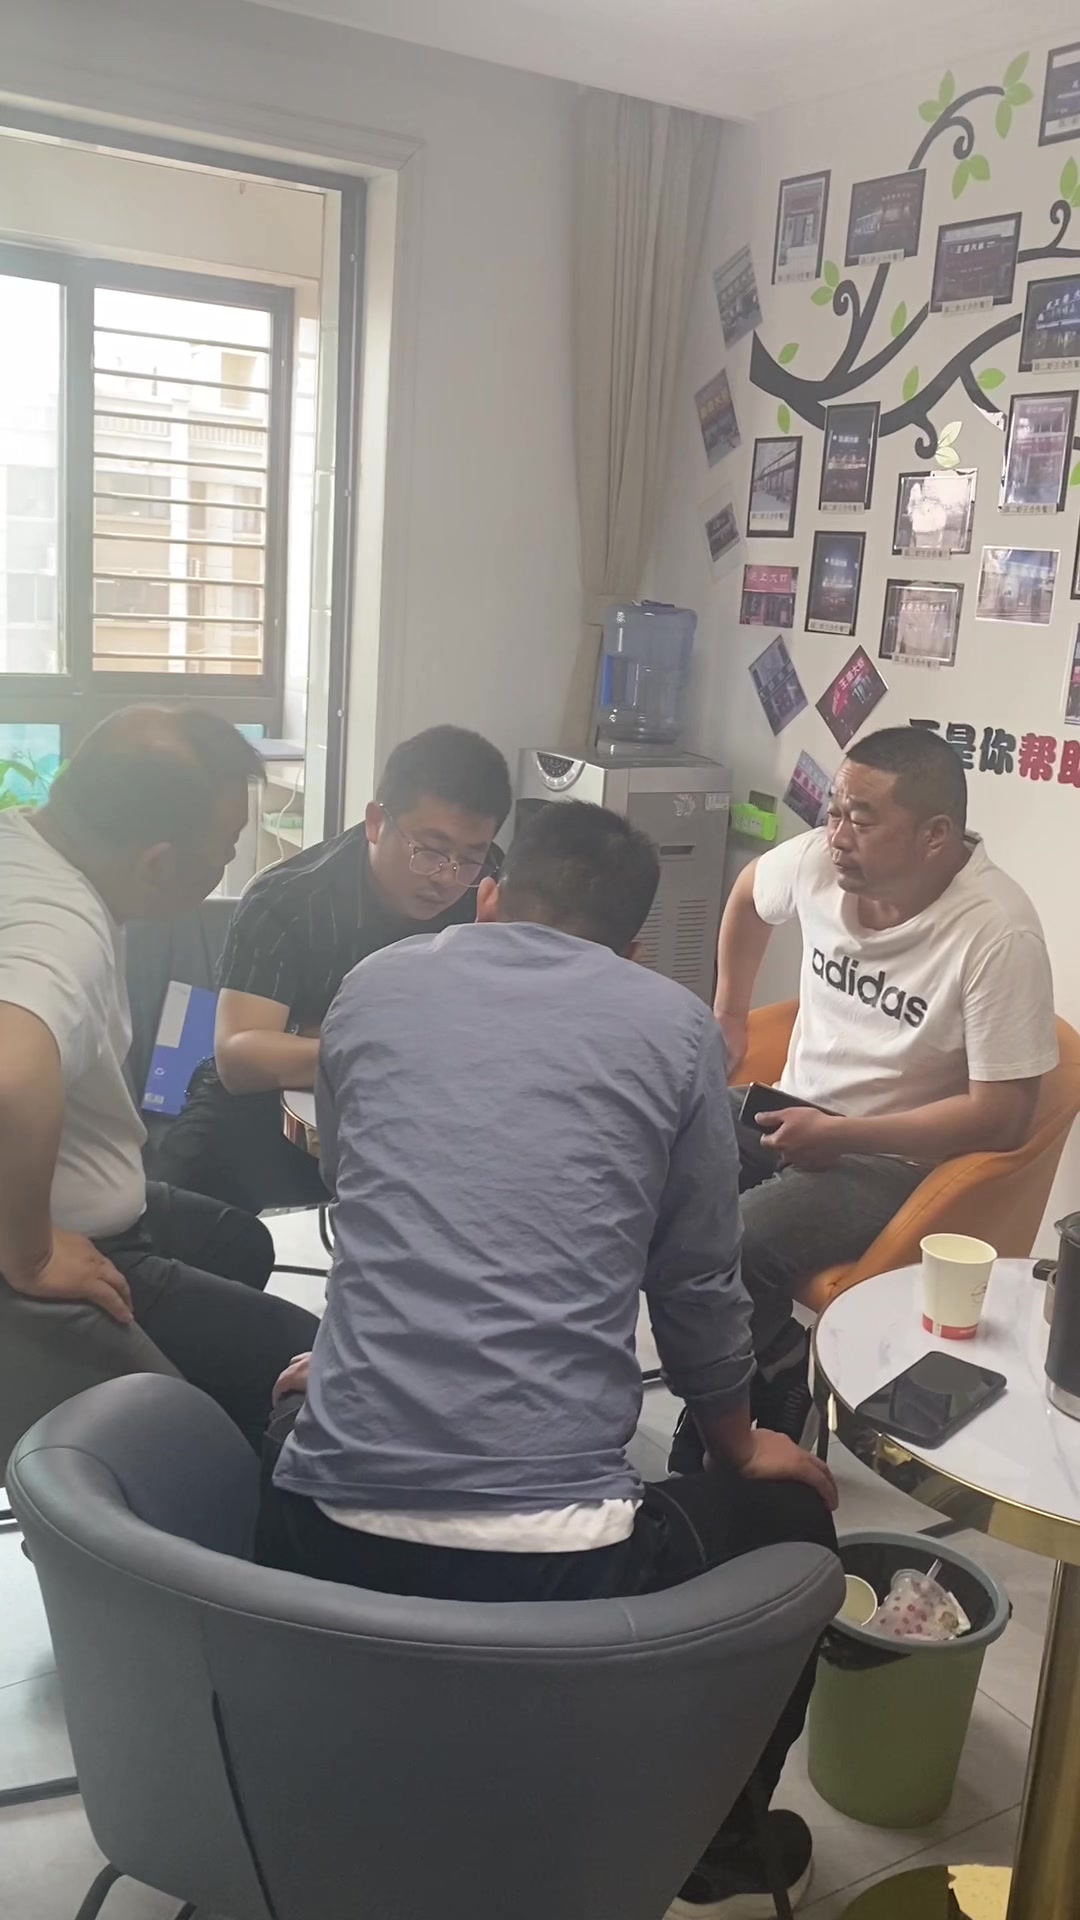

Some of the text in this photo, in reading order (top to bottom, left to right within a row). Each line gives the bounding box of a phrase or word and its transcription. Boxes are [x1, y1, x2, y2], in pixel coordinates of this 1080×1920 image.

[908, 718, 1080, 789] 是你帮助
[811, 947, 928, 1028] adidas
